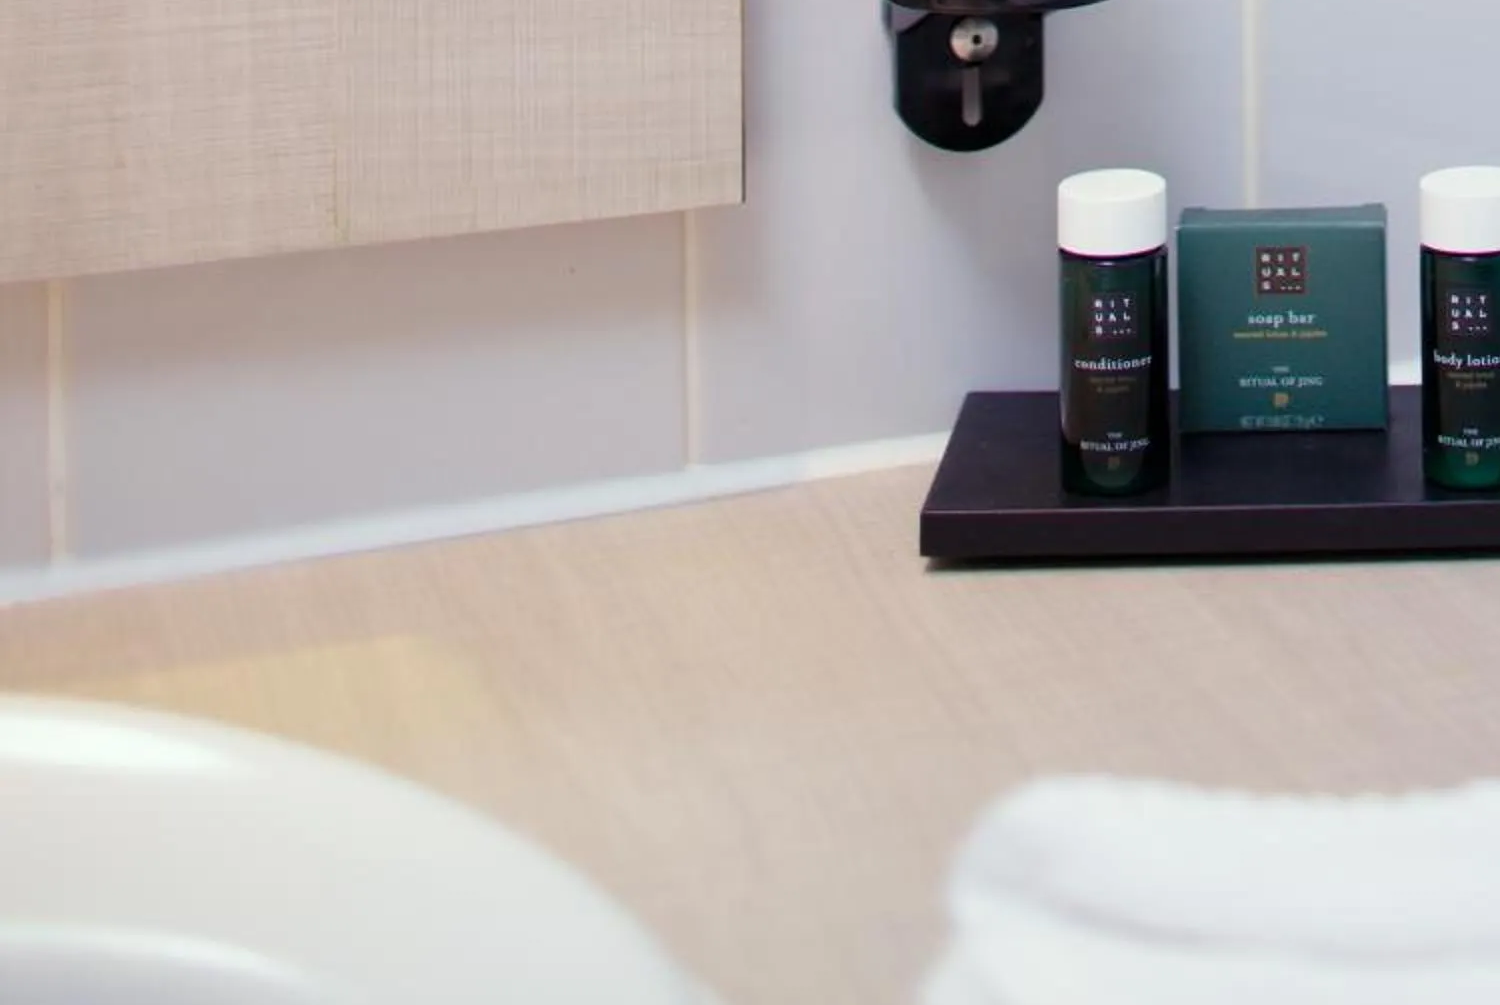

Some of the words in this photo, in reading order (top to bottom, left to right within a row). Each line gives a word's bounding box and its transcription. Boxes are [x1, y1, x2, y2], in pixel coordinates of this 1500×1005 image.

[1247, 312, 1284, 328] soap
[1288, 310, 1316, 324] bar
[1074, 355, 1153, 370] conditioner
[1433, 349, 1463, 369] body
[1239, 377, 1278, 387] RITUAL
[1281, 376, 1295, 387] OF
